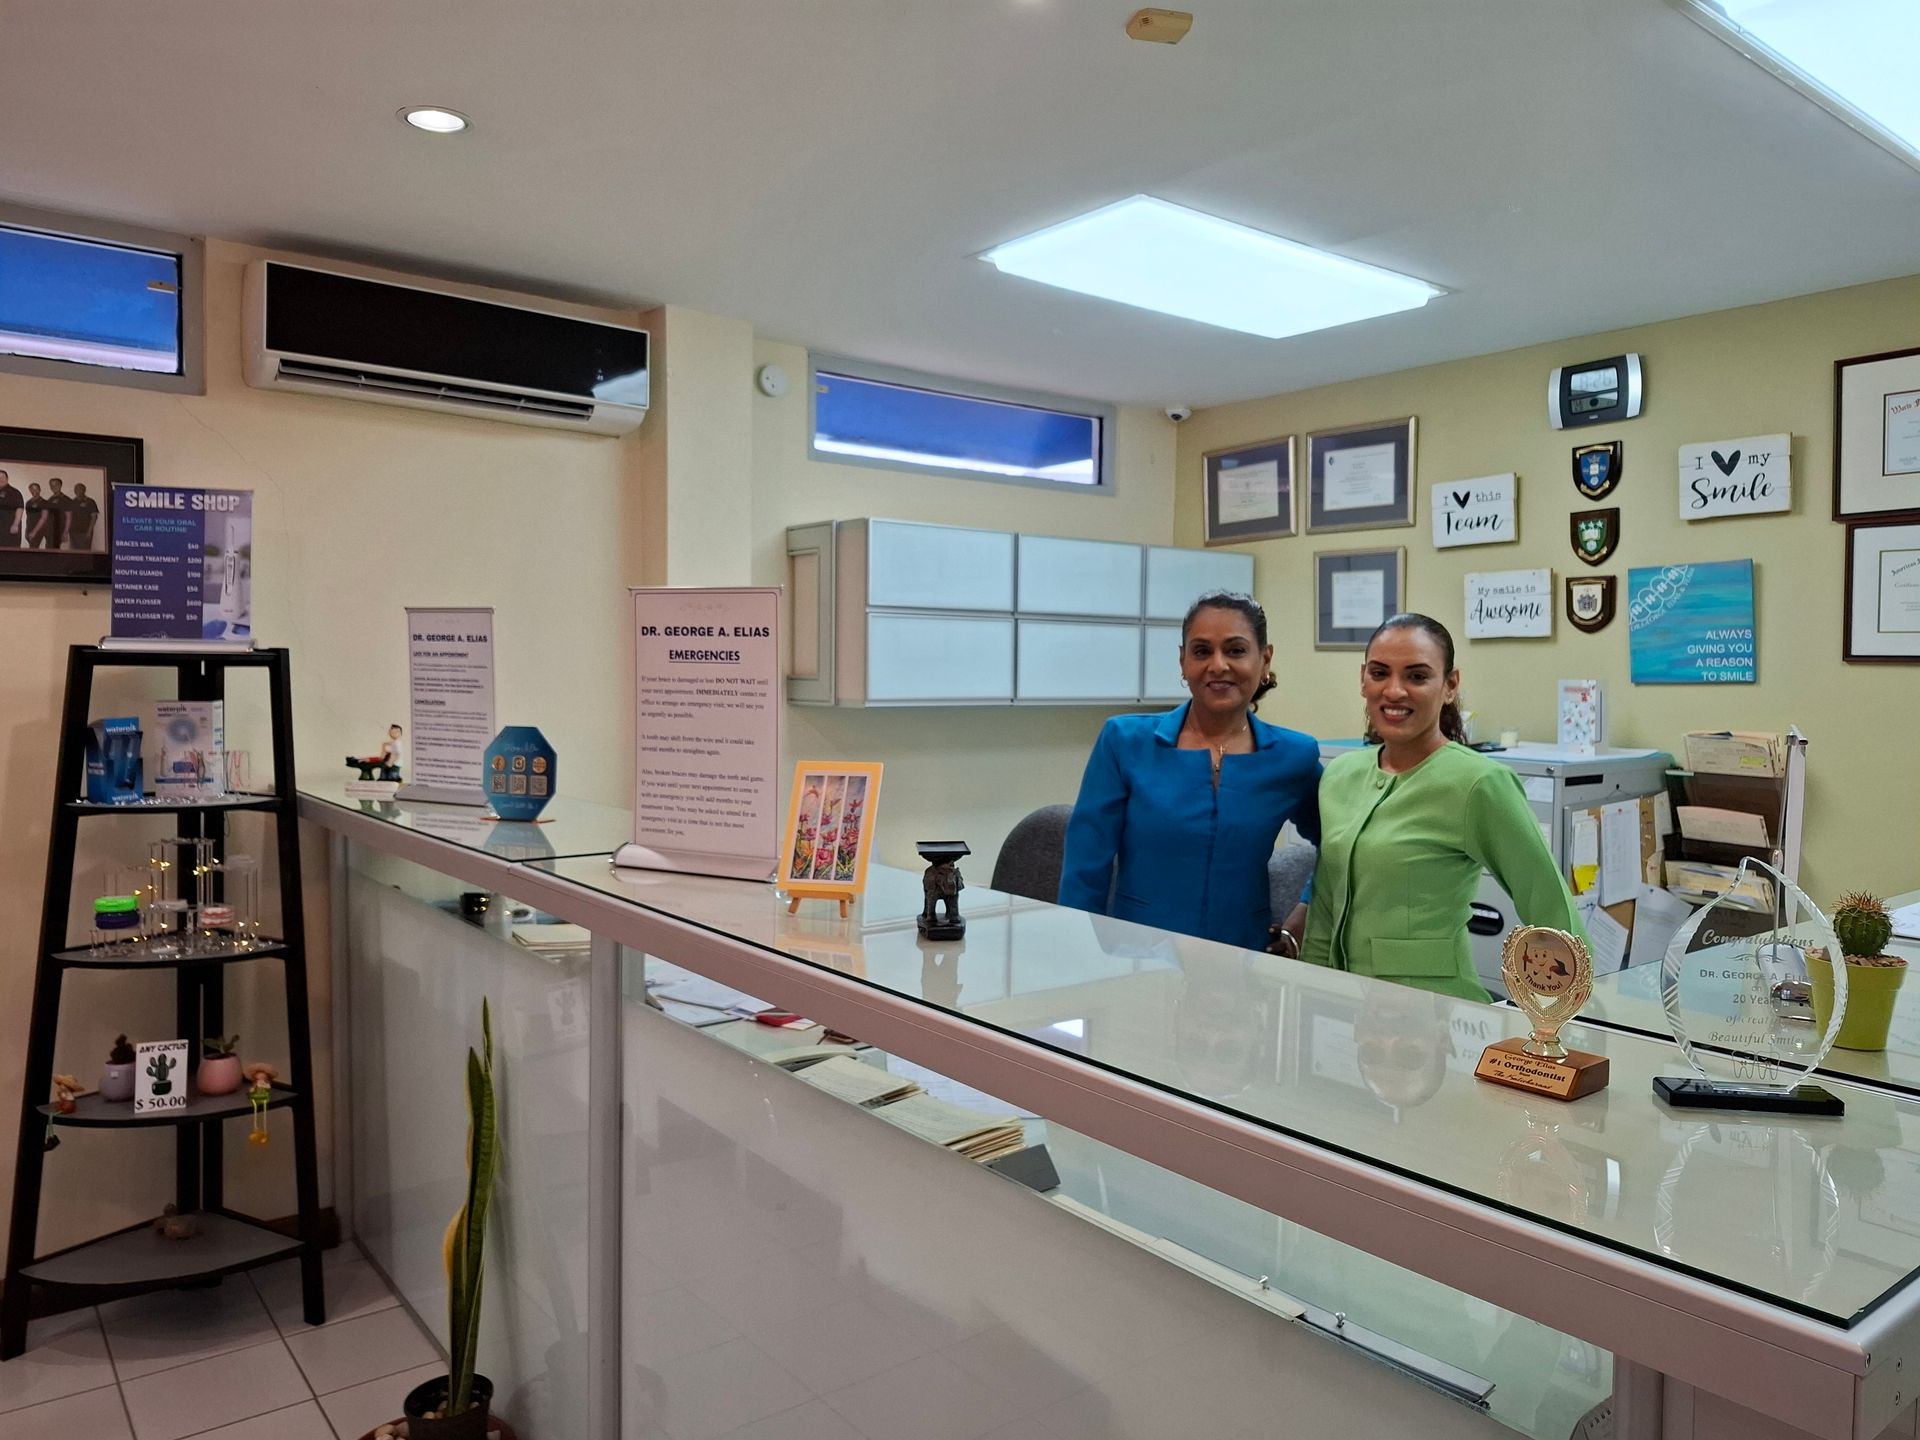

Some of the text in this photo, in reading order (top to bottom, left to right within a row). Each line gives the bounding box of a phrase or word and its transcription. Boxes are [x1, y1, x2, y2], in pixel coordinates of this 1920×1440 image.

[1695, 452, 1771, 470] I my
[1691, 472, 1775, 509] Smile
[125, 490, 240, 512] SMILE SHOP
[1443, 491, 1501, 506] I this
[122, 516, 152, 524] ELEVATE
[176, 519, 196, 527] ORAL
[1442, 511, 1503, 535] Team
[1478, 584, 1536, 597] My smile is
[1470, 598, 1544, 624] Awesome
[642, 626, 770, 637] DR. GEORGE A. ELIAS
[1706, 629, 1752, 640] ALWAYS
[426, 634, 456, 642] GEORGE
[1687, 644, 1752, 654] GIVING YOU
[669, 650, 740, 661] EMERGENCIES
[1696, 658, 1752, 668] A REASON
[1702, 672, 1754, 682] TO SMILE
[157, 704, 186, 713] waterpik
[106, 724, 137, 734] waterpik
[1700, 970, 1718, 978] DR.
[1722, 970, 1766, 980] GEORGE
[1525, 974, 1564, 991] Thank You!
[1733, 994, 1746, 1004] 20
[1710, 1032, 1766, 1047] Beautiful
[140, 1043, 188, 1053] ANY CACTUS
[1504, 1054, 1532, 1065] George
[1490, 1058, 1566, 1082] #1 Orthodontist
[136, 1096, 186, 1110] $ 50.00
